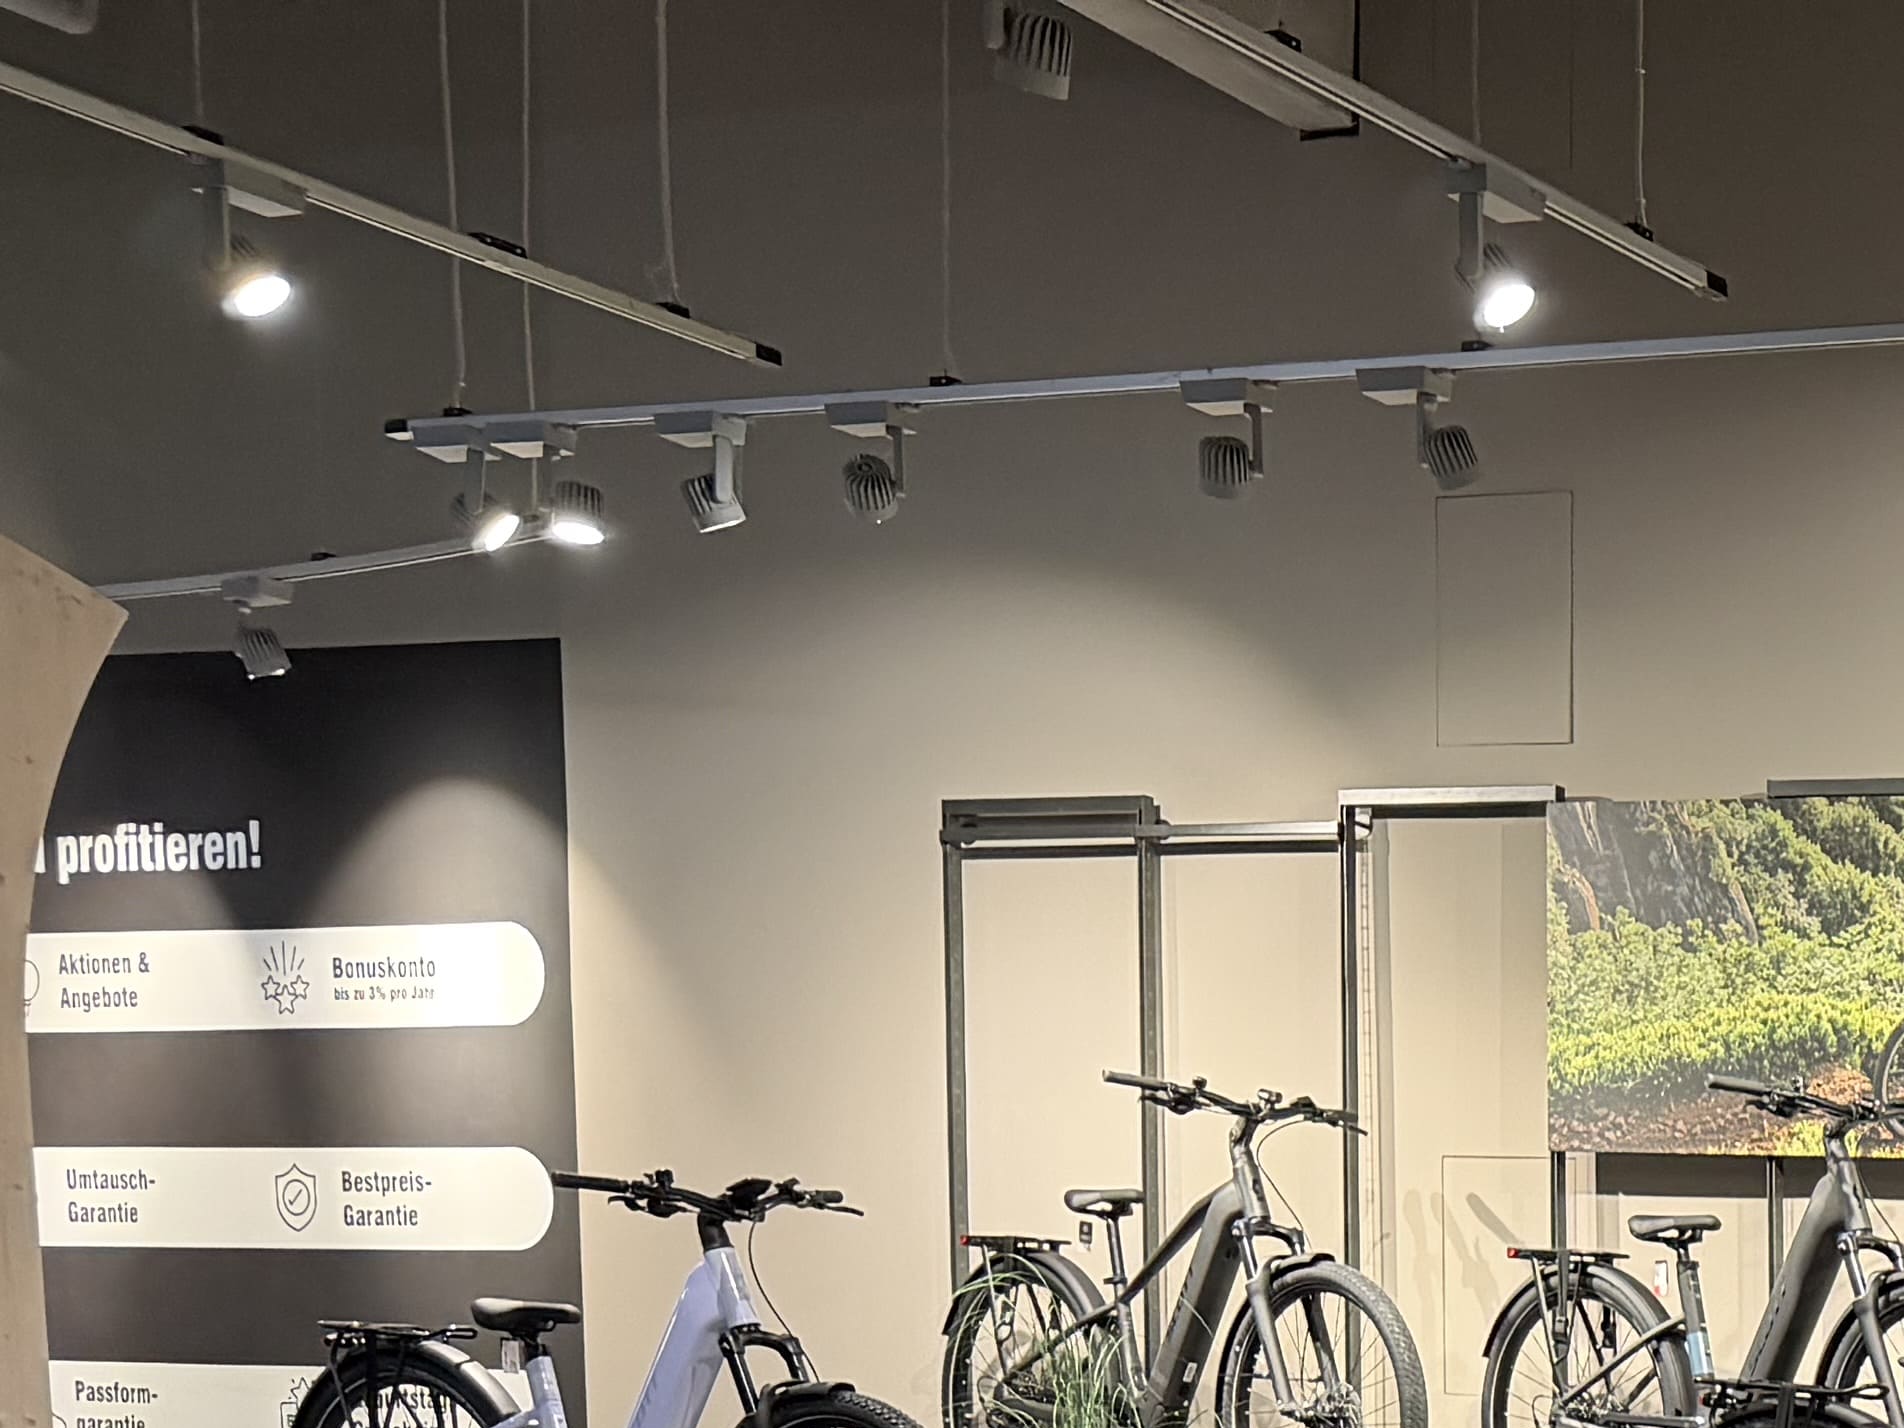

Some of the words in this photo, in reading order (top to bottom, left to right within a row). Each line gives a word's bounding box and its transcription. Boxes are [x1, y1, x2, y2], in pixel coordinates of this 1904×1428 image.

[56, 820, 262, 885] profitieren!
[58, 953, 131, 975] Aktionen
[138, 951, 150, 974] &
[332, 956, 436, 979] Bonuskonto
[60, 986, 139, 1012] Angebote
[66, 1169, 156, 1191] Umtausch-
[341, 1171, 433, 1197] Bestpreis-
[68, 1201, 139, 1224] Garantie
[343, 1205, 419, 1227] Garantie
[75, 1381, 159, 1404] Passform-
